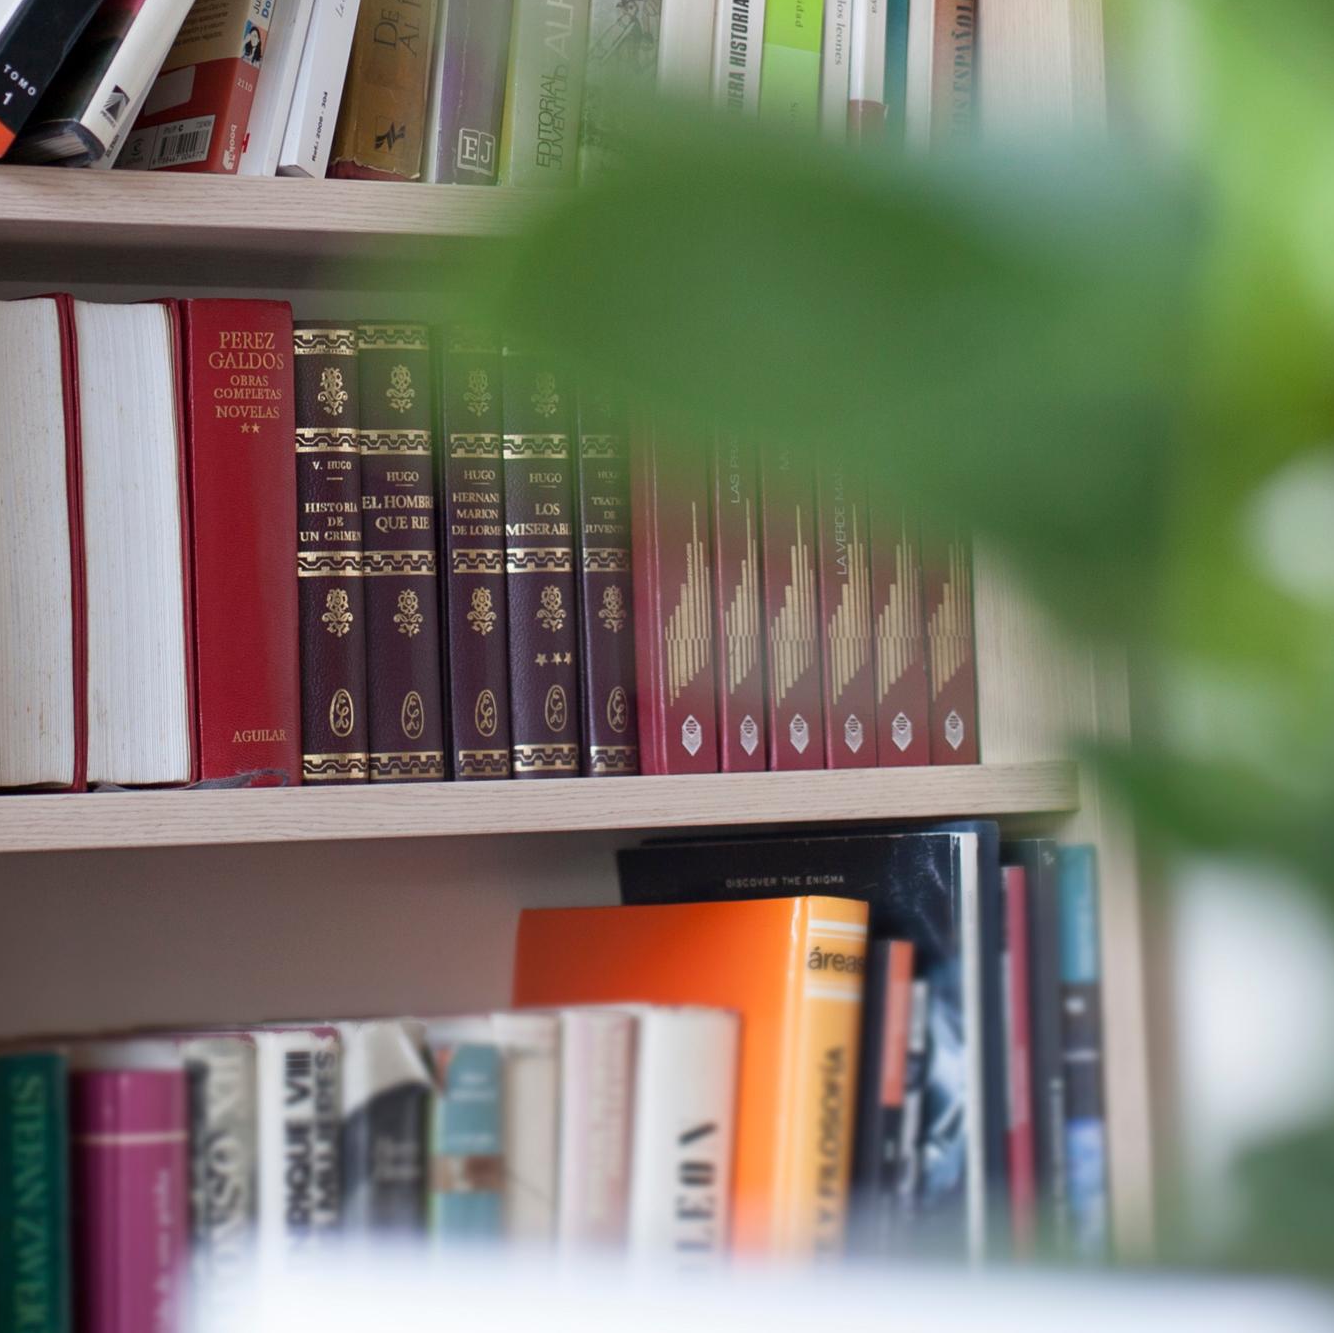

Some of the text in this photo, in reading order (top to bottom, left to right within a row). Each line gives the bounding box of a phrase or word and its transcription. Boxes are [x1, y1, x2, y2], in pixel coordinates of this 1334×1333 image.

[374, 9, 400, 50] DE
[834, 21, 847, 66] leones
[3, 64, 37, 96] TOMO
[3, 92, 13, 105] 1
[536, 74, 556, 168] EDITORIAL
[219, 331, 276, 350] PEREZ
[208, 350, 285, 370] GALDOS
[230, 374, 269, 387] OBRAS
[213, 387, 282, 400] COMPLETAS
[215, 405, 281, 419] NOVELAS
[312, 460, 352, 470] V. HUGO
[386, 471, 420, 482] HUGO
[463, 470, 496, 481] HUGO
[529, 472, 562, 484] HUGO
[304, 502, 359, 514] HISTORIA
[361, 496, 382, 510] EL
[535, 503, 561, 516] LOS
[456, 509, 499, 520] MARION
[328, 516, 344, 527] DE
[375, 516, 430, 534] QUE RIE
[299, 531, 320, 542] UN
[451, 525, 468, 537] DE
[834, 506, 848, 576] LA VERDE
[232, 729, 287, 745] AGUILAR
[725, 874, 846, 889] DISCOVER THE ENIGMA
